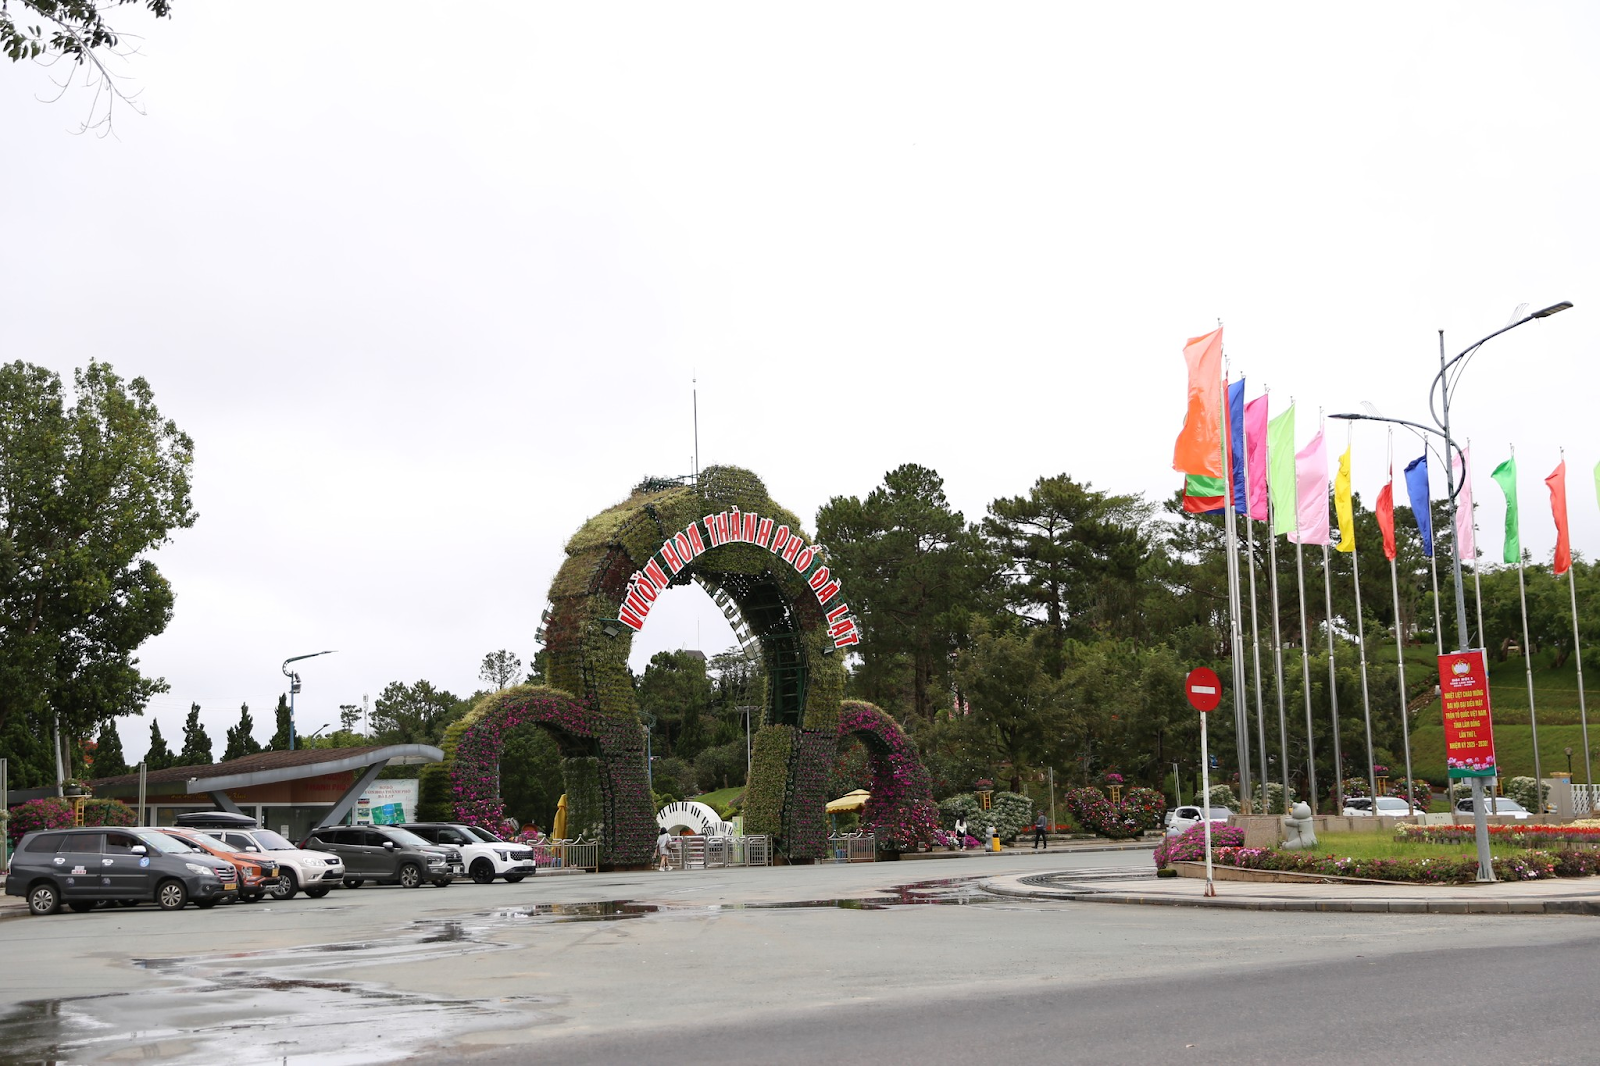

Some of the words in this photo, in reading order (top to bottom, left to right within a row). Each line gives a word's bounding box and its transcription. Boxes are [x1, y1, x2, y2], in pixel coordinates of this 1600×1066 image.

[618, 557, 670, 632] VƯỜN
[660, 522, 706, 575] HOA
[703, 505, 774, 548] THÀNH
[770, 525, 822, 574] PHỐ
[808, 566, 842, 606] ĐÀ
[826, 603, 860, 648] LẠT
